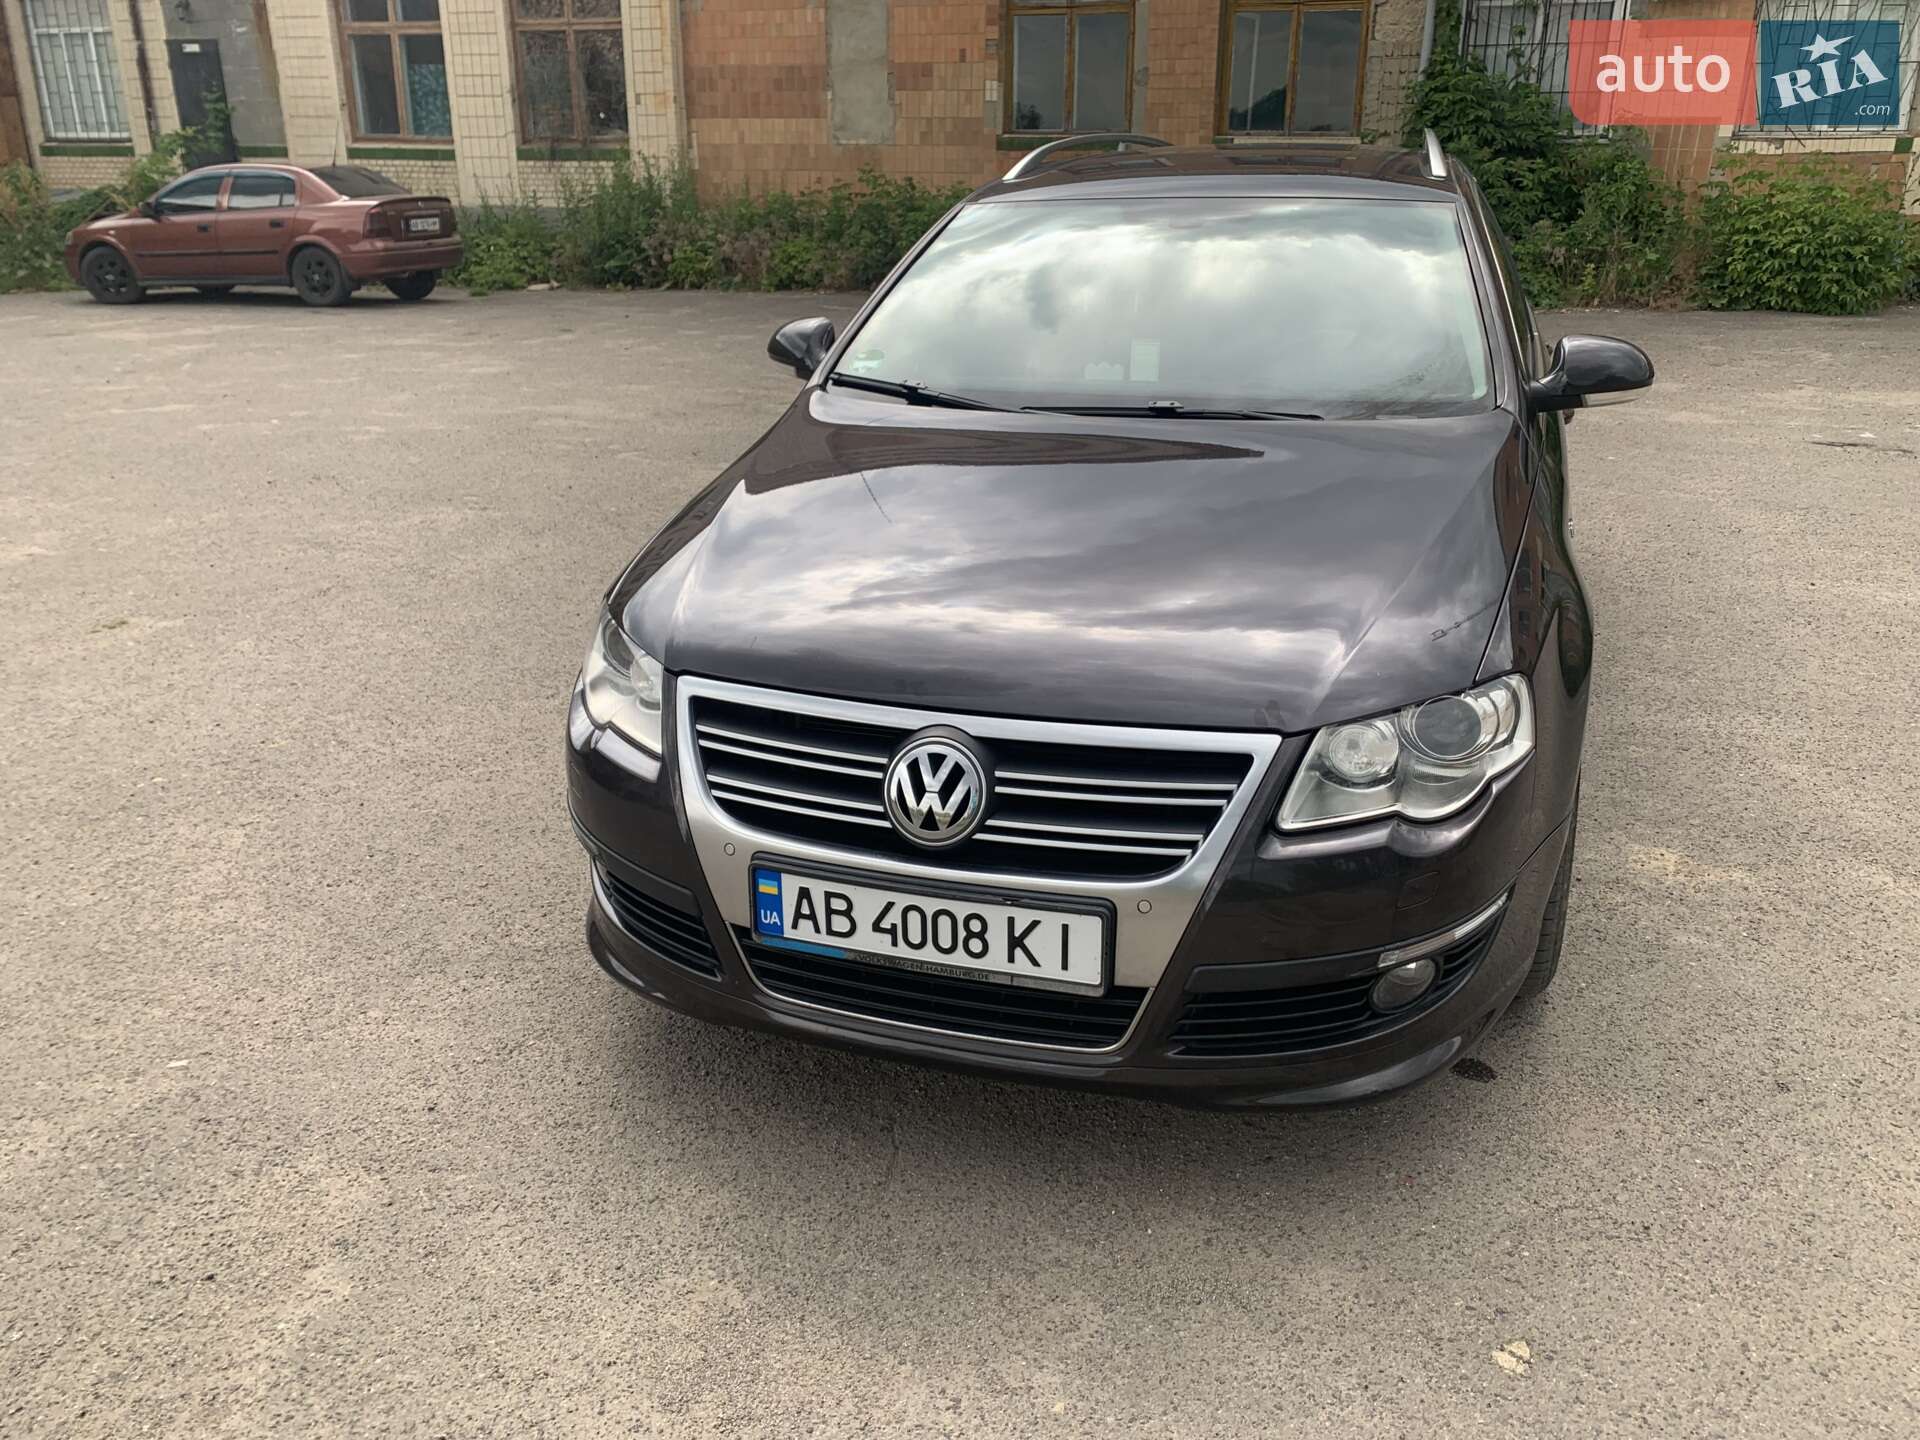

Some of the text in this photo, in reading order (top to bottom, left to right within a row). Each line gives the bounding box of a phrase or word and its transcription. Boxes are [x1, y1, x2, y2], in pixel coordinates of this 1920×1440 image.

[891, 744, 979, 839] VW
[760, 909, 780, 926] UA
[791, 886, 857, 938] AB
[871, 901, 989, 959] 4008
